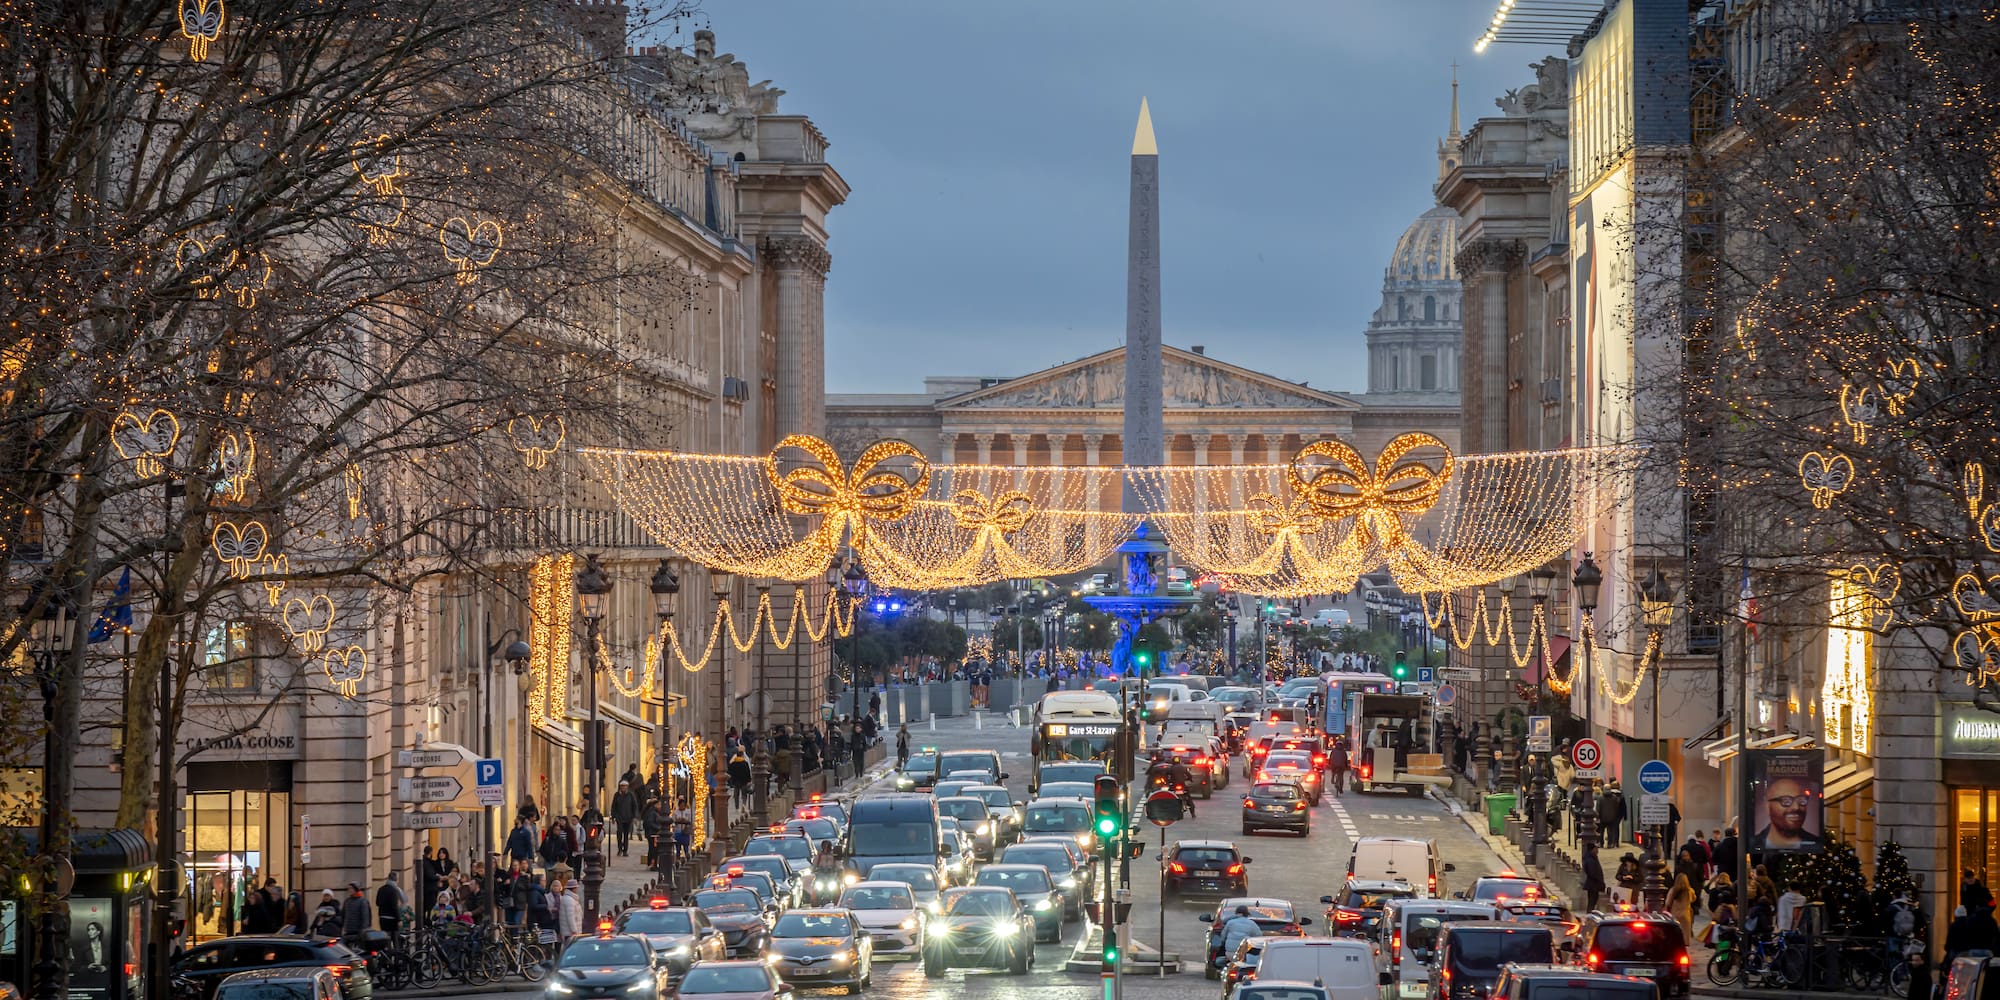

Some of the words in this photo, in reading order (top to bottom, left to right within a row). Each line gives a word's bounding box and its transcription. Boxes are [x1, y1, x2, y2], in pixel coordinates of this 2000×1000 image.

[1421, 670, 1429, 680] P
[1069, 726, 1085, 735] Gare
[1086, 726, 1117, 735] St-Lazare
[1534, 720, 1545, 734] P
[248, 736, 295, 749] GOOSE
[1579, 748, 1596, 761] 50
[483, 764, 496, 782] P
